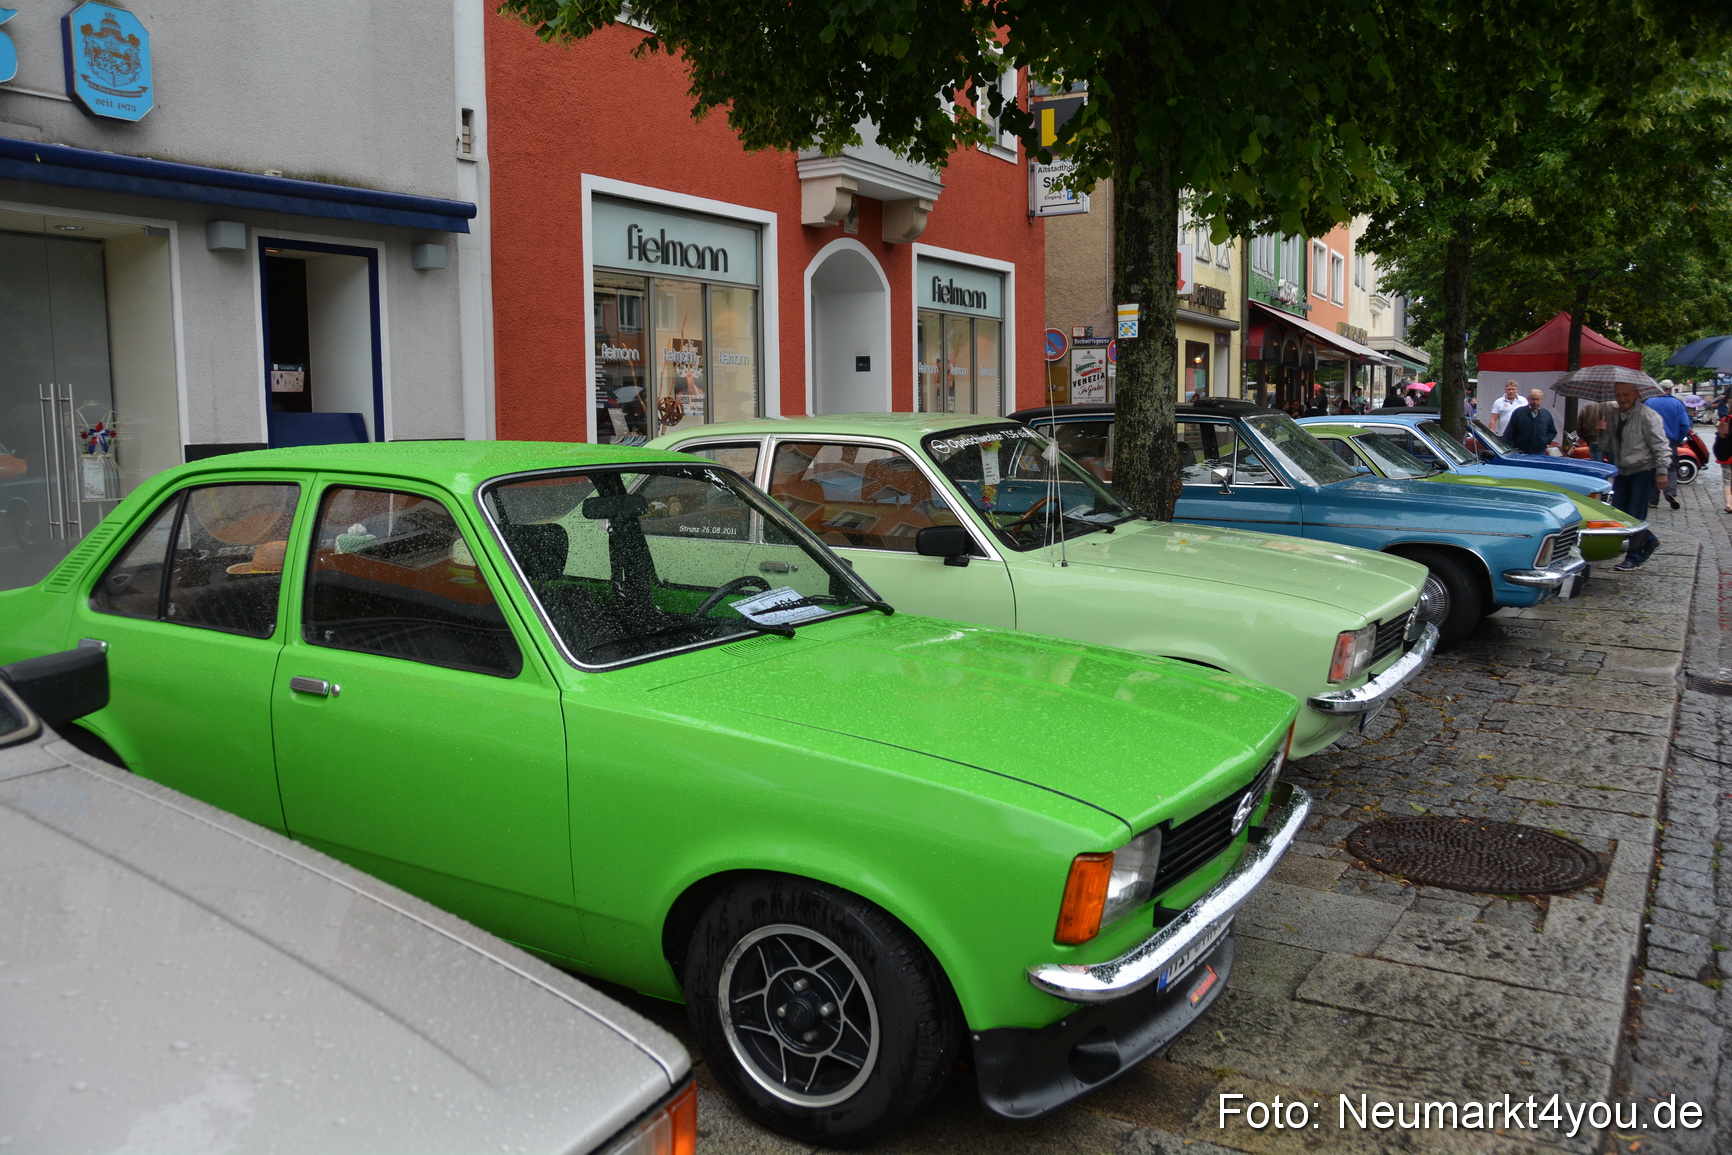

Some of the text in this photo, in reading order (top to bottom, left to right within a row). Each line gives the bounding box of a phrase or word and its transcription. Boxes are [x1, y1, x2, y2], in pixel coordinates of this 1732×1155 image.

[95, 98, 137, 112] seit 1873
[627, 223, 728, 273] fielmann
[931, 275, 987, 310] fielmann
[1073, 372, 1105, 388] VENEZIA
